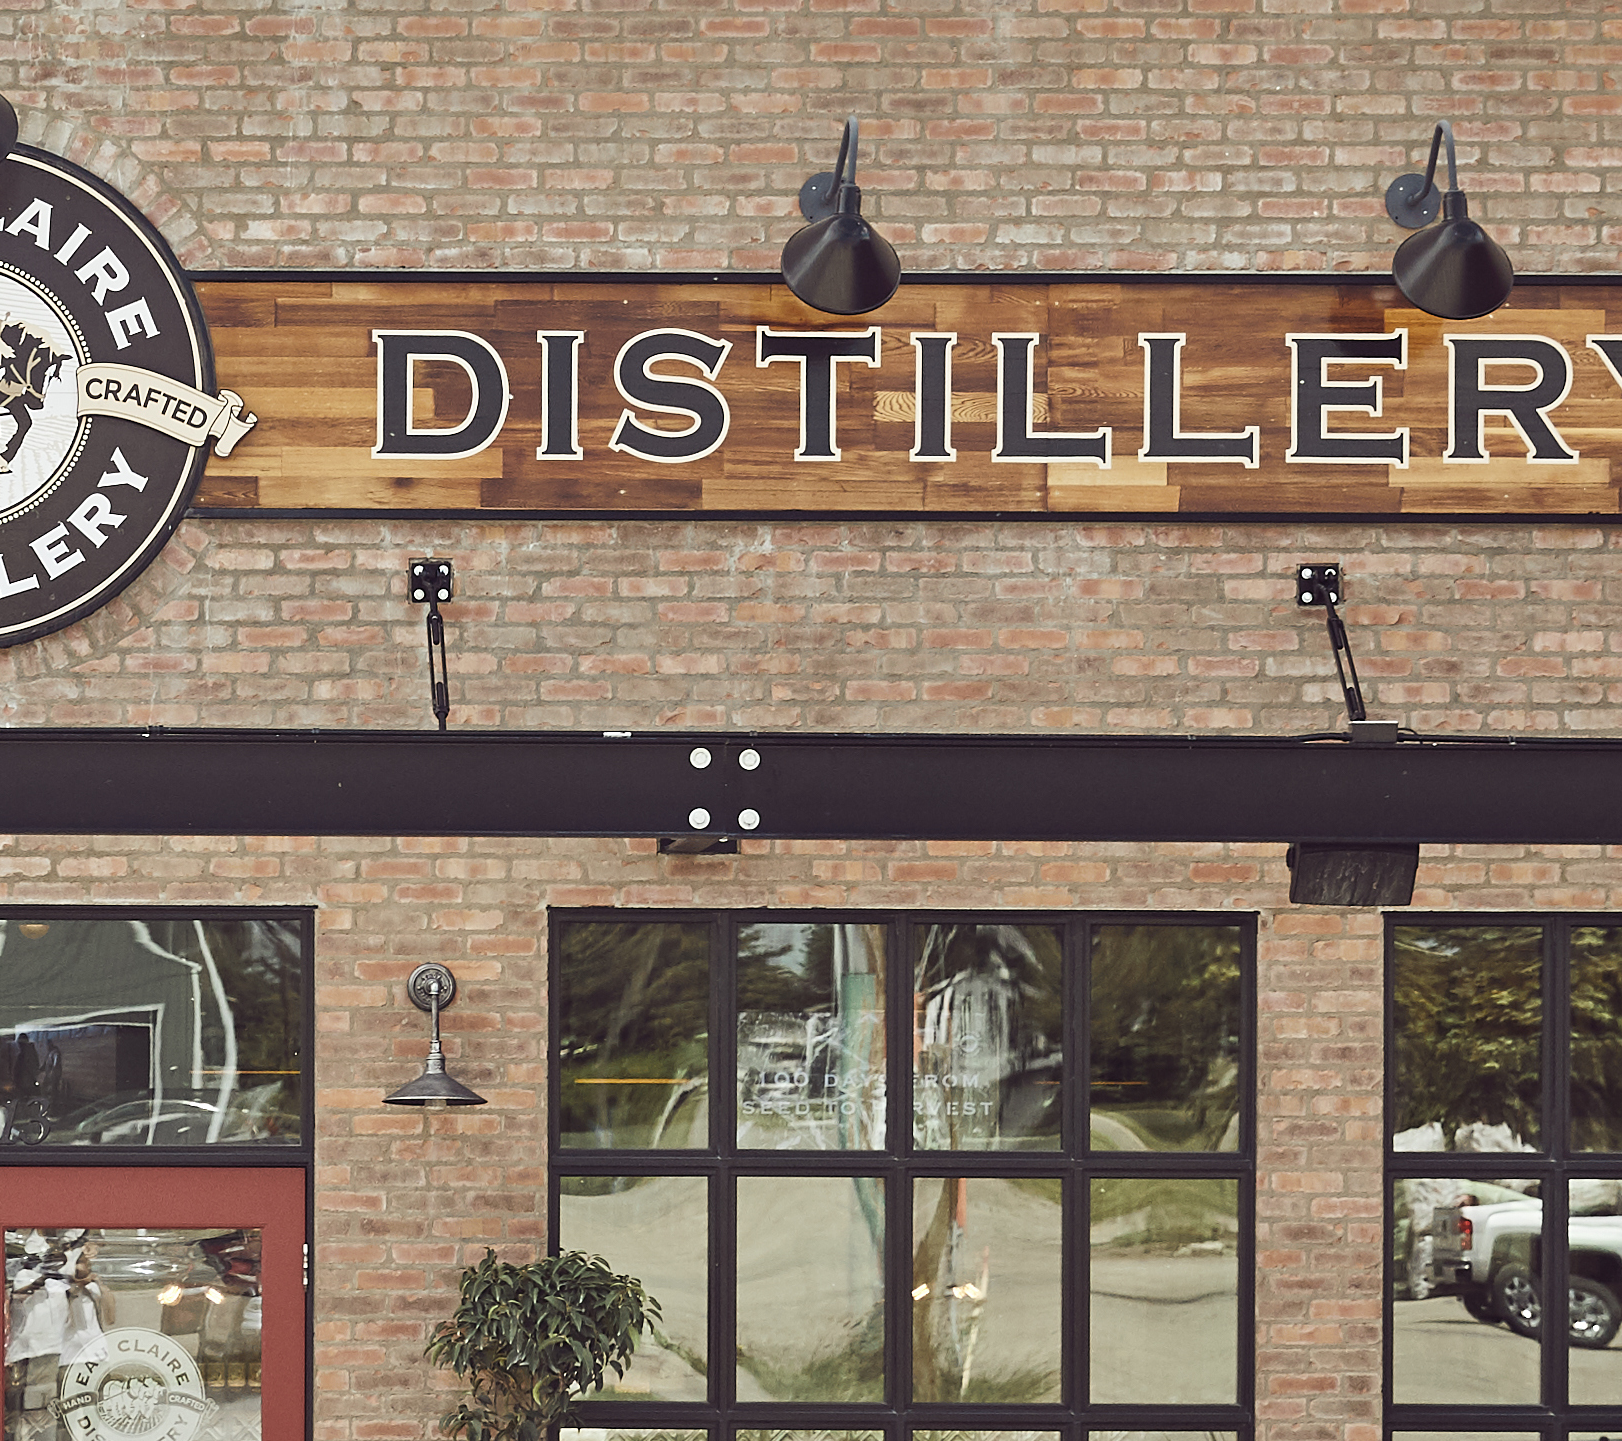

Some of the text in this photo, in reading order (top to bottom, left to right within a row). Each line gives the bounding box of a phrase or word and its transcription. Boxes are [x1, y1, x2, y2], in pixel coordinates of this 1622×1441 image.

[85, 378, 208, 430] CRAFTED
[760, 1071, 809, 1088] 100
[742, 1101, 993, 1116] SEED TO HRVEST
[76, 1339, 190, 1386] EAU CLAIRE
[63, 1394, 206, 1411] HAND CRAFTED
